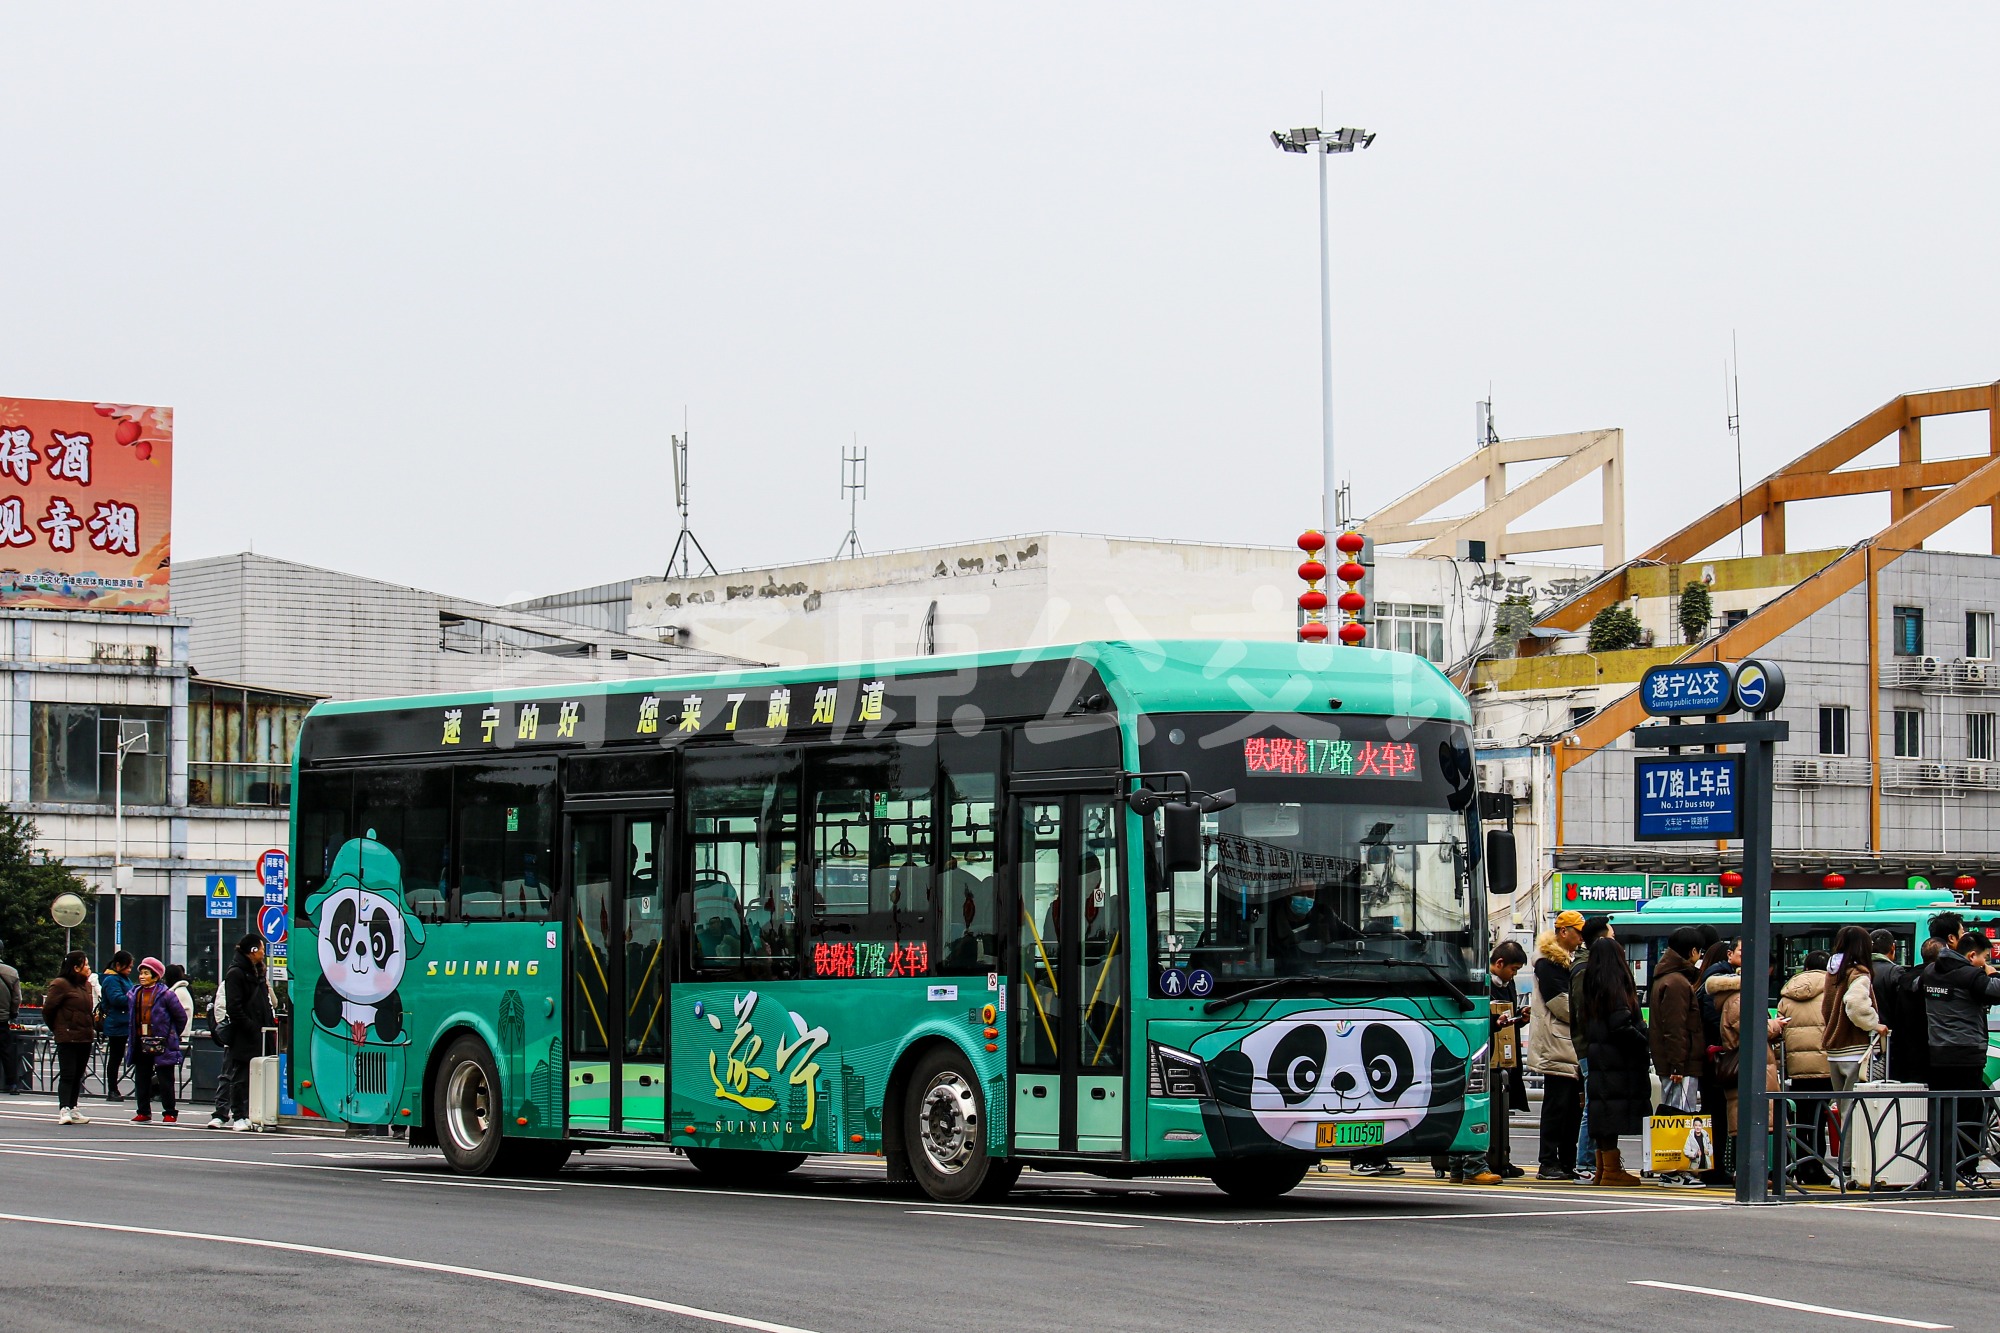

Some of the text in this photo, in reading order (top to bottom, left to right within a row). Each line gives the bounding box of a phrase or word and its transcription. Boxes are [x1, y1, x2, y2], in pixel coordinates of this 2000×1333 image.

[1652, 671, 1719, 698] 遂宁公交
[1652, 697, 1719, 708] Suining public transport
[441, 681, 885, 745] 遂宁的好 您来了就知道
[1646, 767, 1730, 799] 17路上车点
[1661, 801, 1673, 809] No.
[1685, 800, 1697, 808] bus
[1699, 800, 1715, 809] stop
[1665, 816, 1709, 826] 火车站 铁路桥
[1580, 886, 1643, 901] 书亦烧仙草
[1671, 883, 1719, 897] 便利店
[1937, 887, 1980, 905] 克士
[854, 942, 886, 977] 17路
[427, 960, 539, 976] SUINING
[715, 1119, 793, 1134] SUINING
[1650, 1118, 1684, 1128] JNVN
